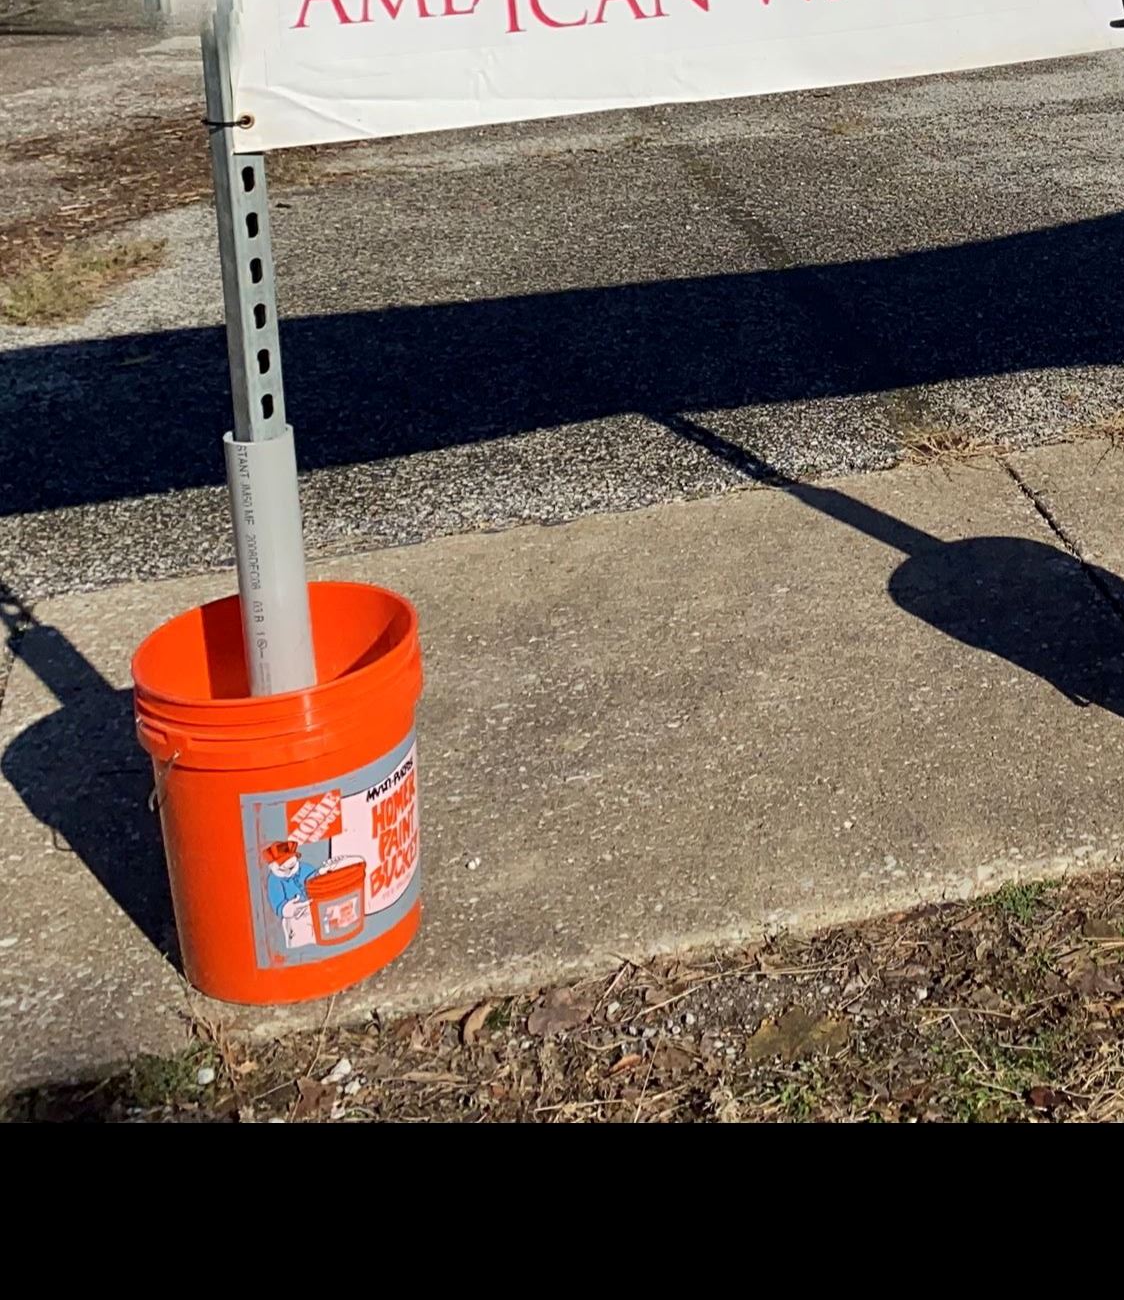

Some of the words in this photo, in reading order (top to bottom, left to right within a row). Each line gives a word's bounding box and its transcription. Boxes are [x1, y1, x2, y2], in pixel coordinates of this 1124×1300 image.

[287, 791, 341, 846] HOME
[290, 799, 316, 824] THE
[371, 769, 415, 840] HOMER
